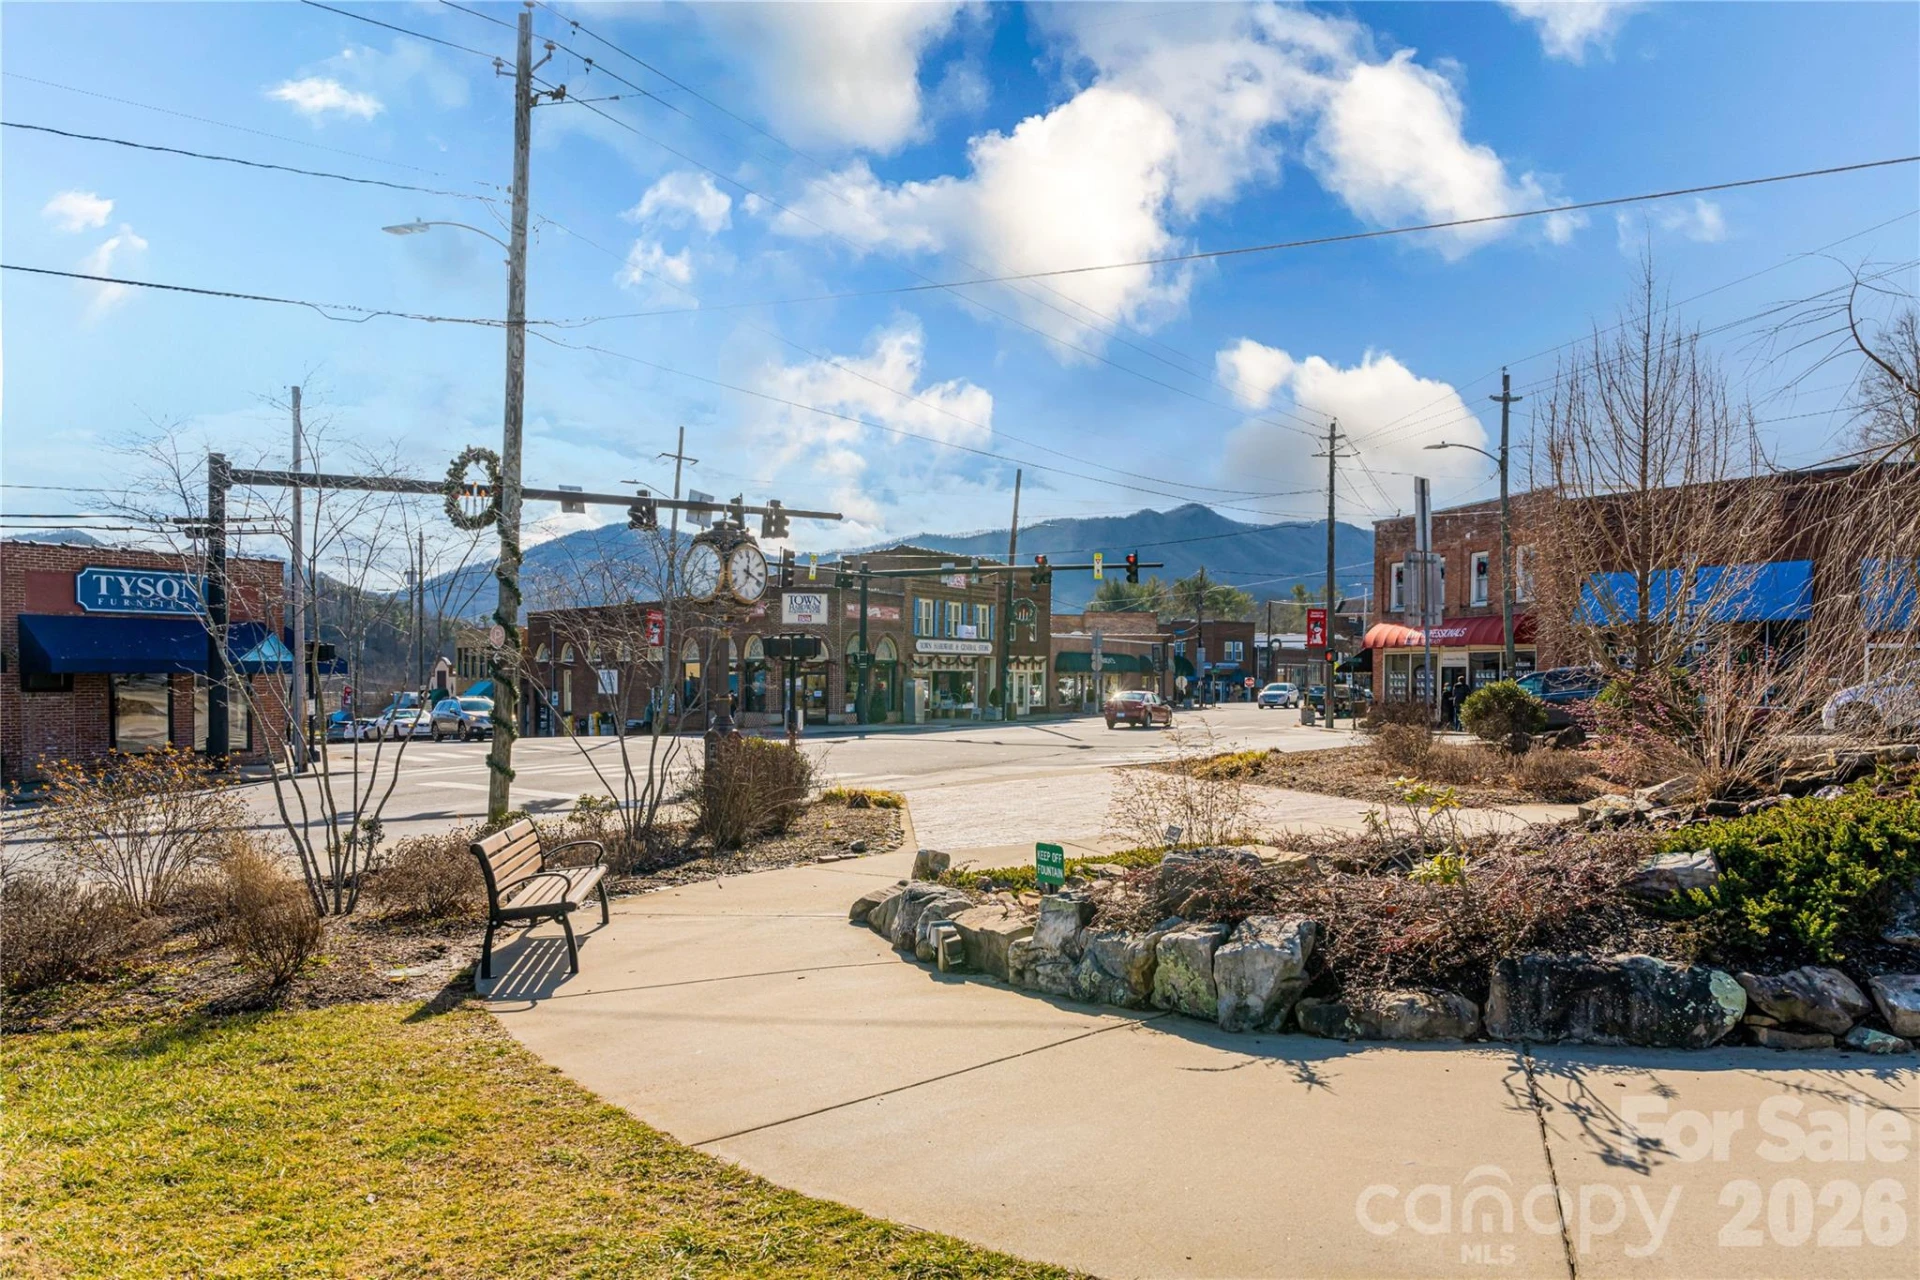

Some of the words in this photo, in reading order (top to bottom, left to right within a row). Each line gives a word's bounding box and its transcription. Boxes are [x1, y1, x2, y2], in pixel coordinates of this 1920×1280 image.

[92, 574, 200, 599] TYSON
[787, 594, 822, 606] TOWN
[1037, 850, 1051, 861] KEEP
[1052, 852, 1062, 863] OFF
[1037, 864, 1064, 878] FOUNTAIN
